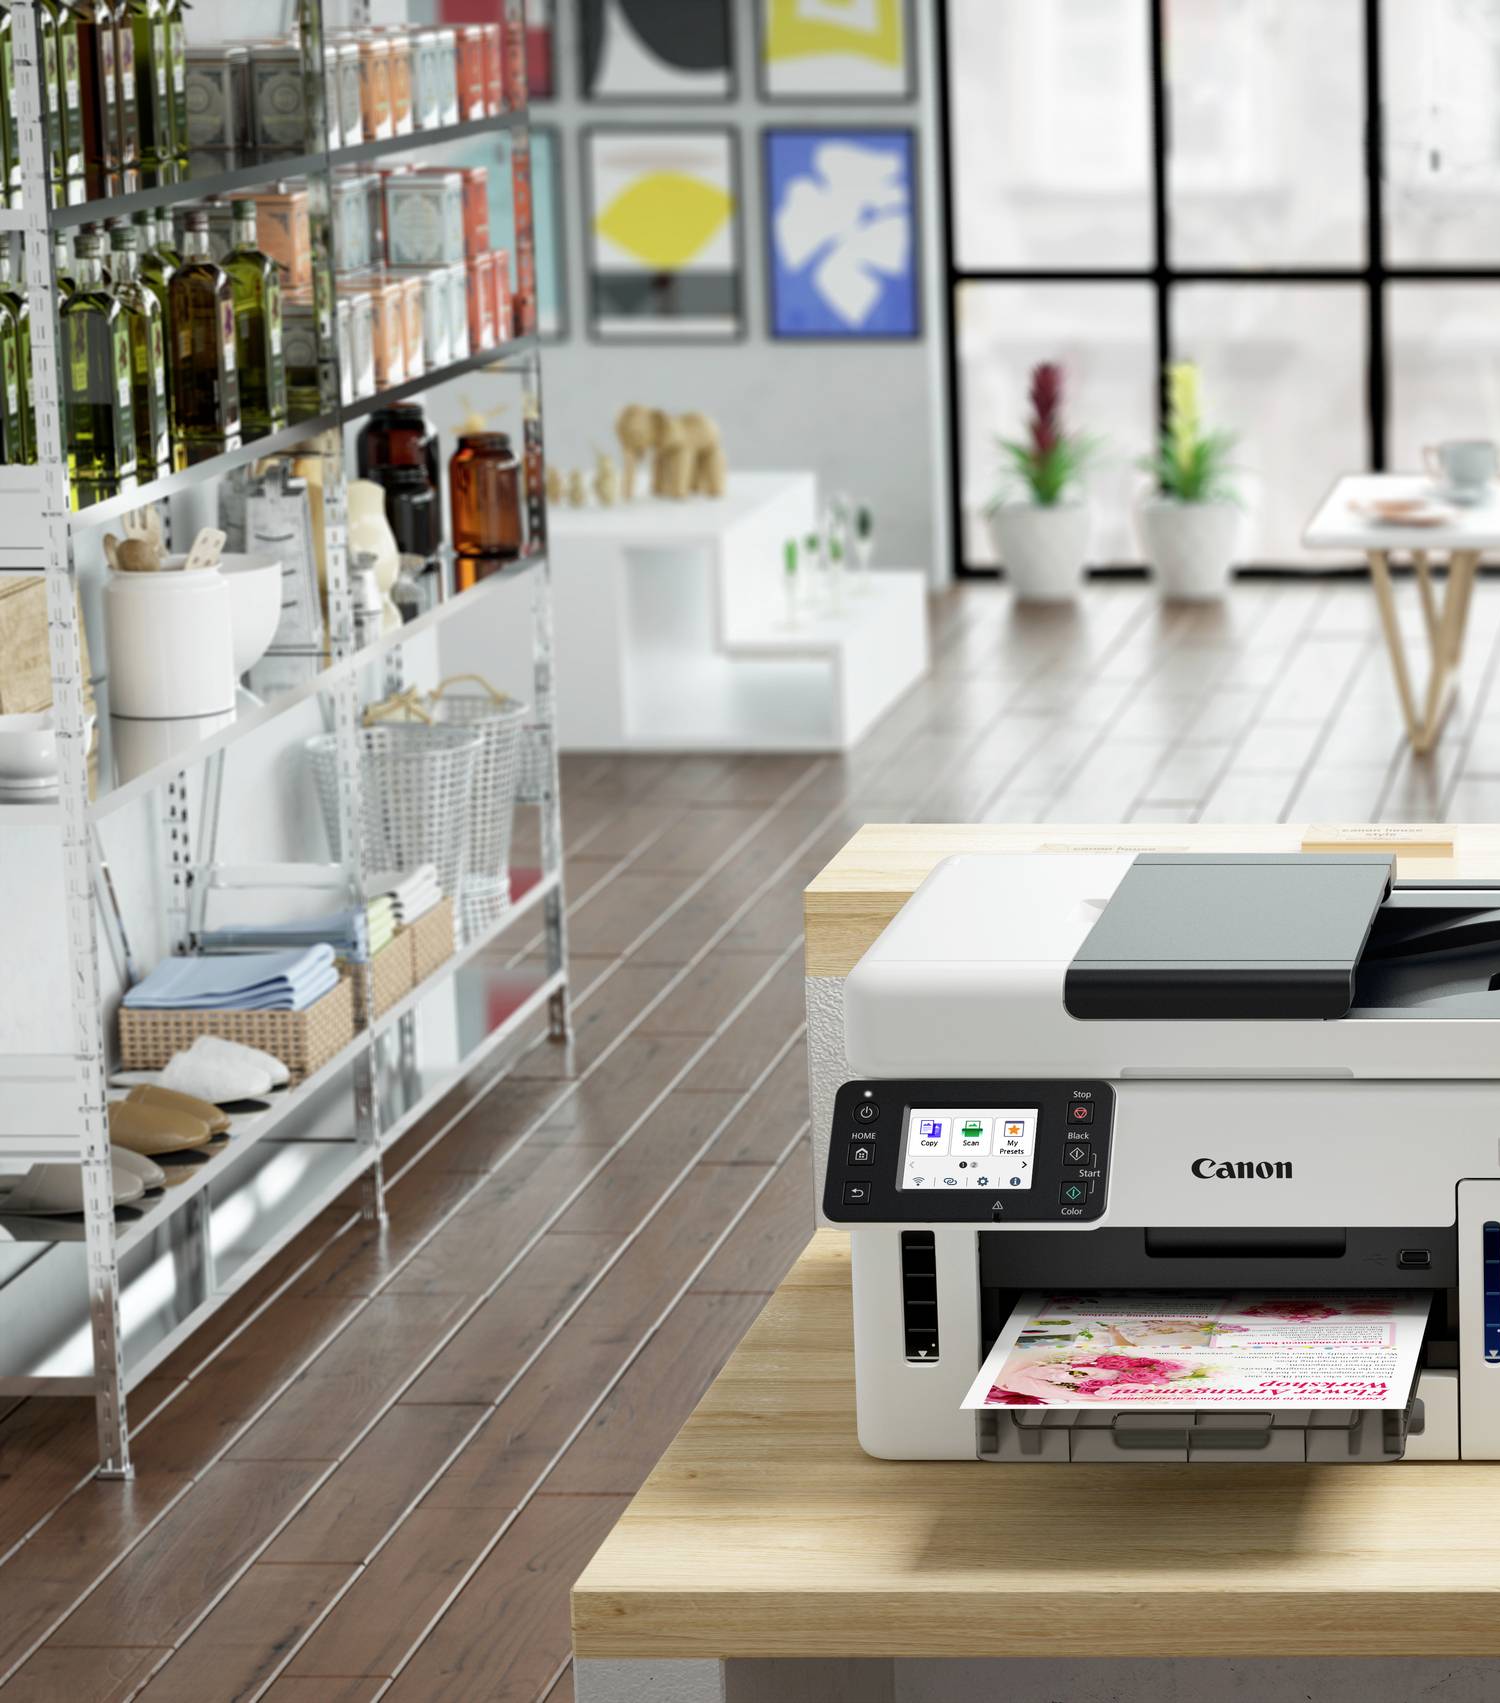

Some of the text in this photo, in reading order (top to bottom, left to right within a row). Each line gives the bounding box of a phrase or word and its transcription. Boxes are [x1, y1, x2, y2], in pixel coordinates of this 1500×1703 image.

[1073, 1090, 1092, 1100] Stop
[852, 1132, 876, 1140] HOME
[1067, 1132, 1090, 1140] Black
[920, 1139, 939, 1148] Copy
[962, 1139, 980, 1147] Scan
[1007, 1140, 1019, 1148] My
[1190, 1157, 1294, 1180] Canon
[1079, 1169, 1101, 1178] Start
[1060, 1207, 1083, 1216] Color
[1259, 1380, 1388, 1389] Workshop
